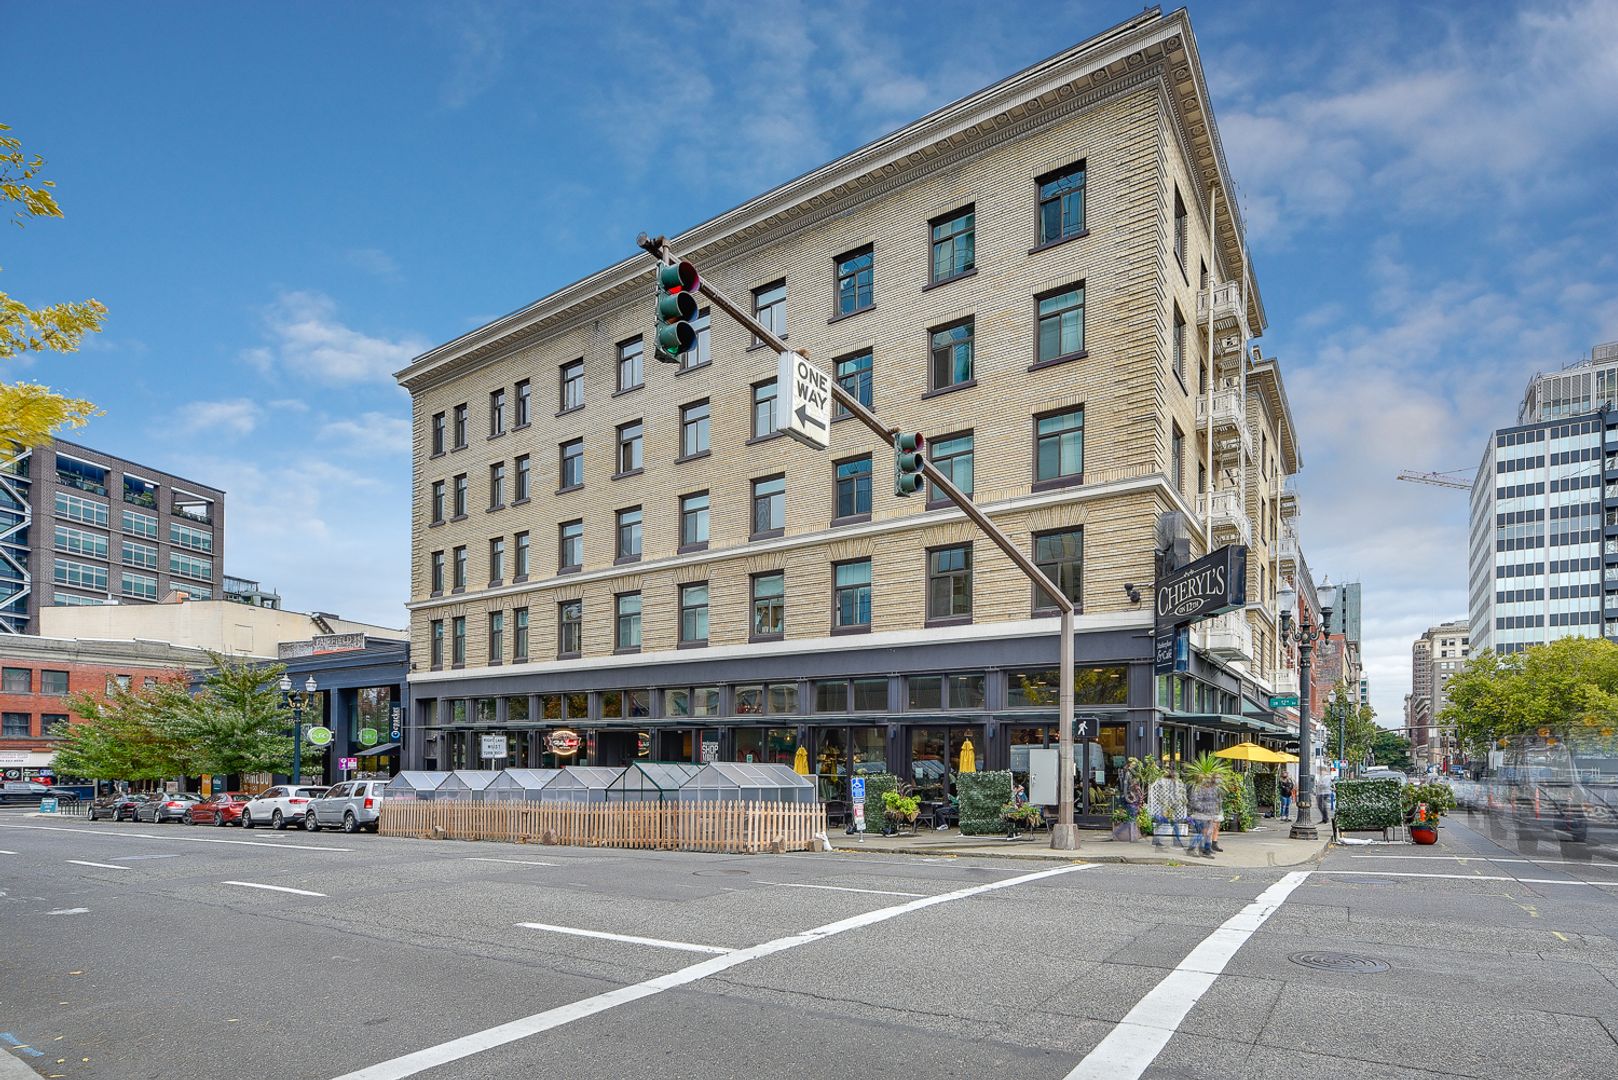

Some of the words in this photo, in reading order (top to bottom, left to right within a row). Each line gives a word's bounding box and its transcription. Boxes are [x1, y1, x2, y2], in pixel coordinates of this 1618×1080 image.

[798, 361, 827, 393] ONE
[797, 380, 827, 410] WAY
[1158, 565, 1225, 616] CHERYL'S
[1186, 601, 1199, 612] 12TH
[702, 744, 719, 754] SHOP
